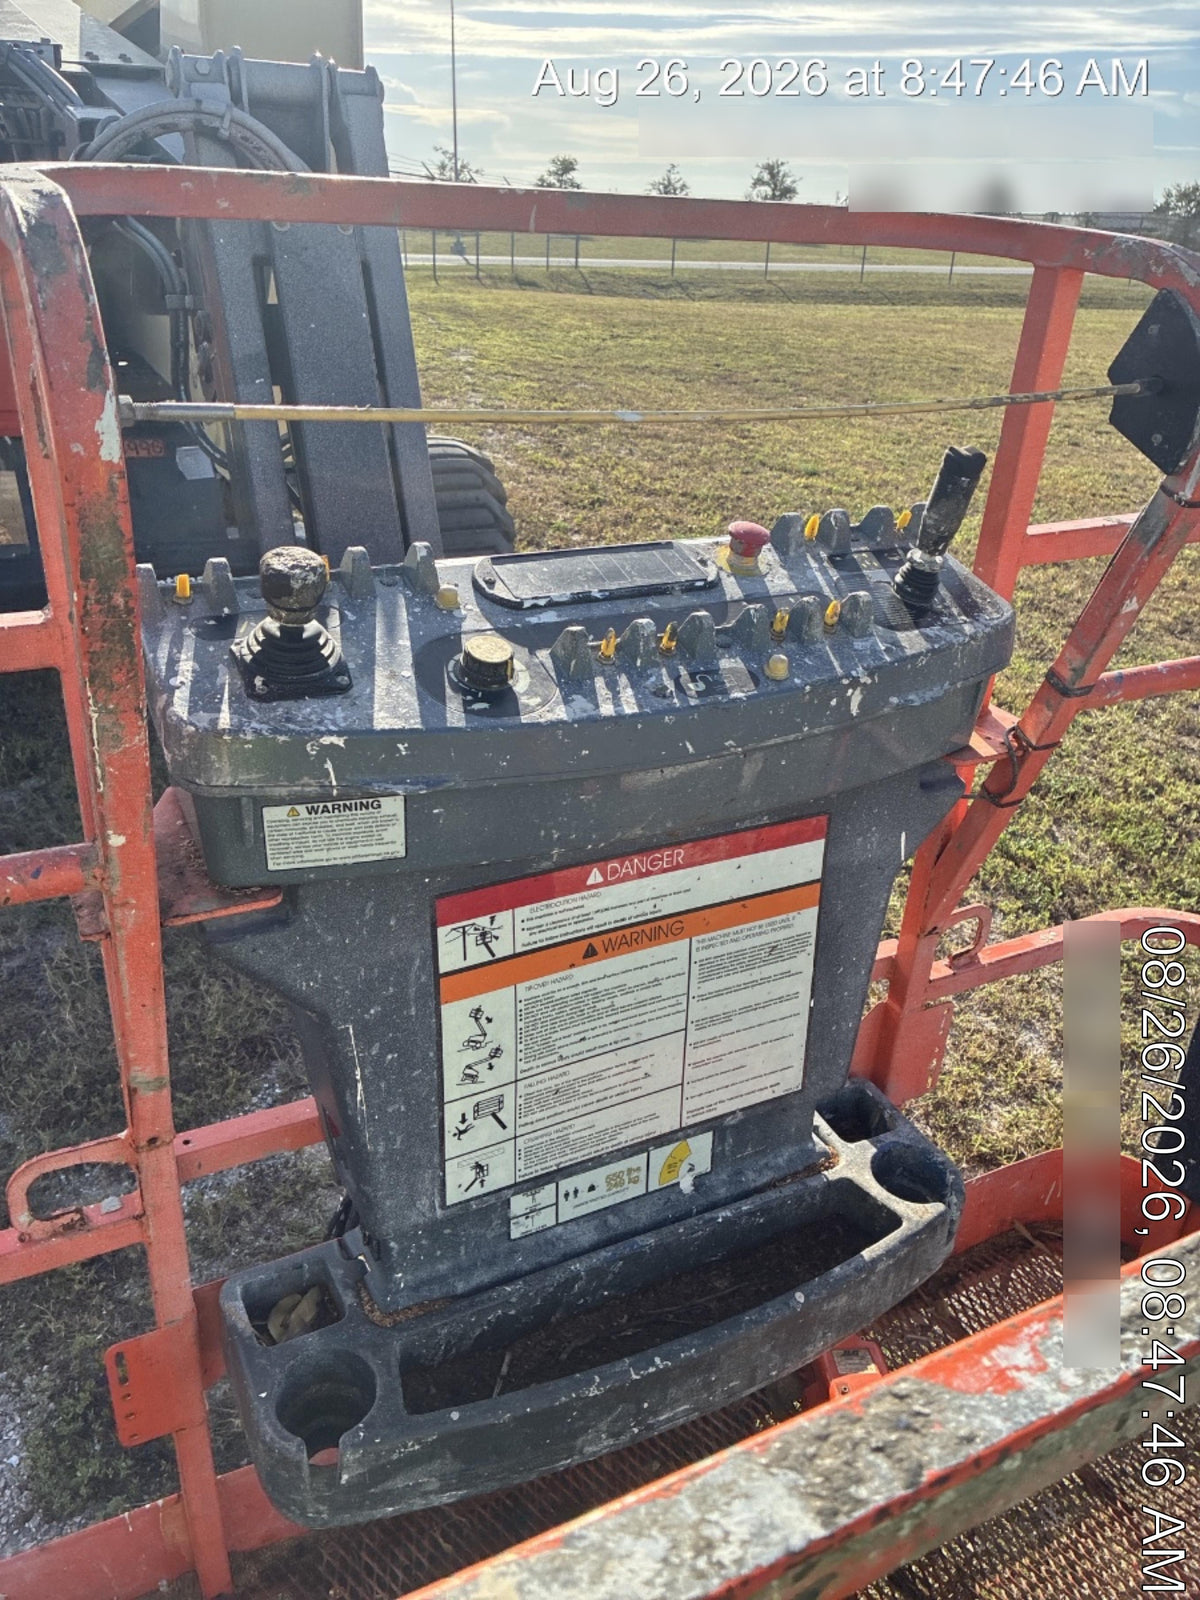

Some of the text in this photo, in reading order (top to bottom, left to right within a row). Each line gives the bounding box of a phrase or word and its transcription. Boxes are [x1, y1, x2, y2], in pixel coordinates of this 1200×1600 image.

[305, 800, 382, 815] WARNING
[607, 849, 685, 881] DANGER
[602, 920, 685, 954] WARNING
